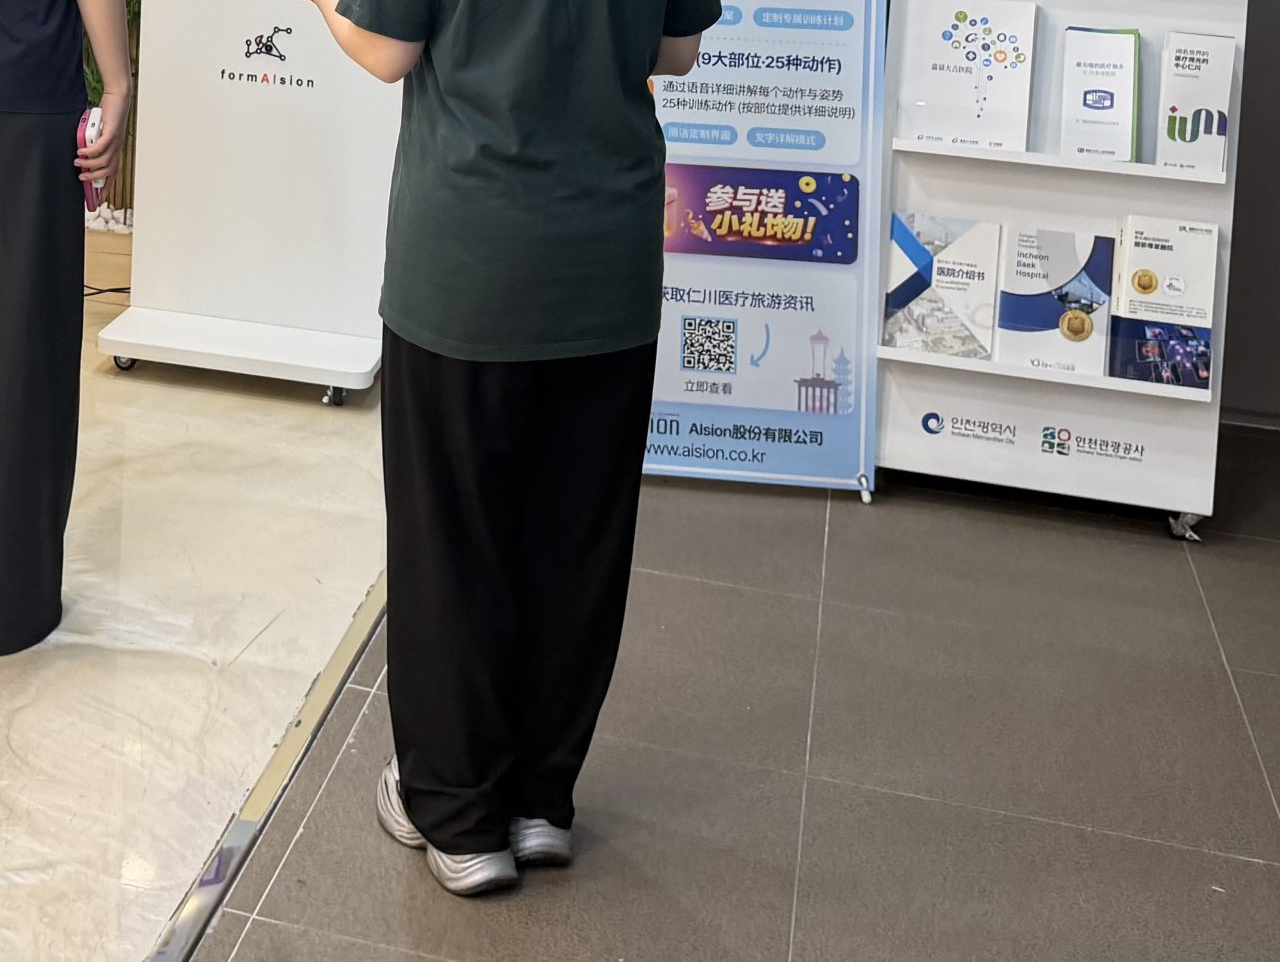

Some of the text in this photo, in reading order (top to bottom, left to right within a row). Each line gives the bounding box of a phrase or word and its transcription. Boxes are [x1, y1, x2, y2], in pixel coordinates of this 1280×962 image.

[697, 51, 843, 76] (9大部位·25种动作)
[221, 69, 314, 88] formAIsion
[662, 80, 843, 102] 通过语音详细讲解每个动作与姿势
[662, 98, 856, 120] 25种训练动作 (按部位提供详细说明)
[705, 184, 786, 214] 参与送
[1016, 260, 1036, 269] Baek
[1017, 251, 1049, 261] Incheon
[937, 267, 985, 281] 医院介绍书
[1016, 270, 1049, 281] Hospital
[684, 380, 732, 395] 立即查看
[689, 422, 823, 447] AIsion股份有限公司
[951, 417, 1016, 438] 인천광역시
[1075, 436, 1144, 456] 인천관광공사
